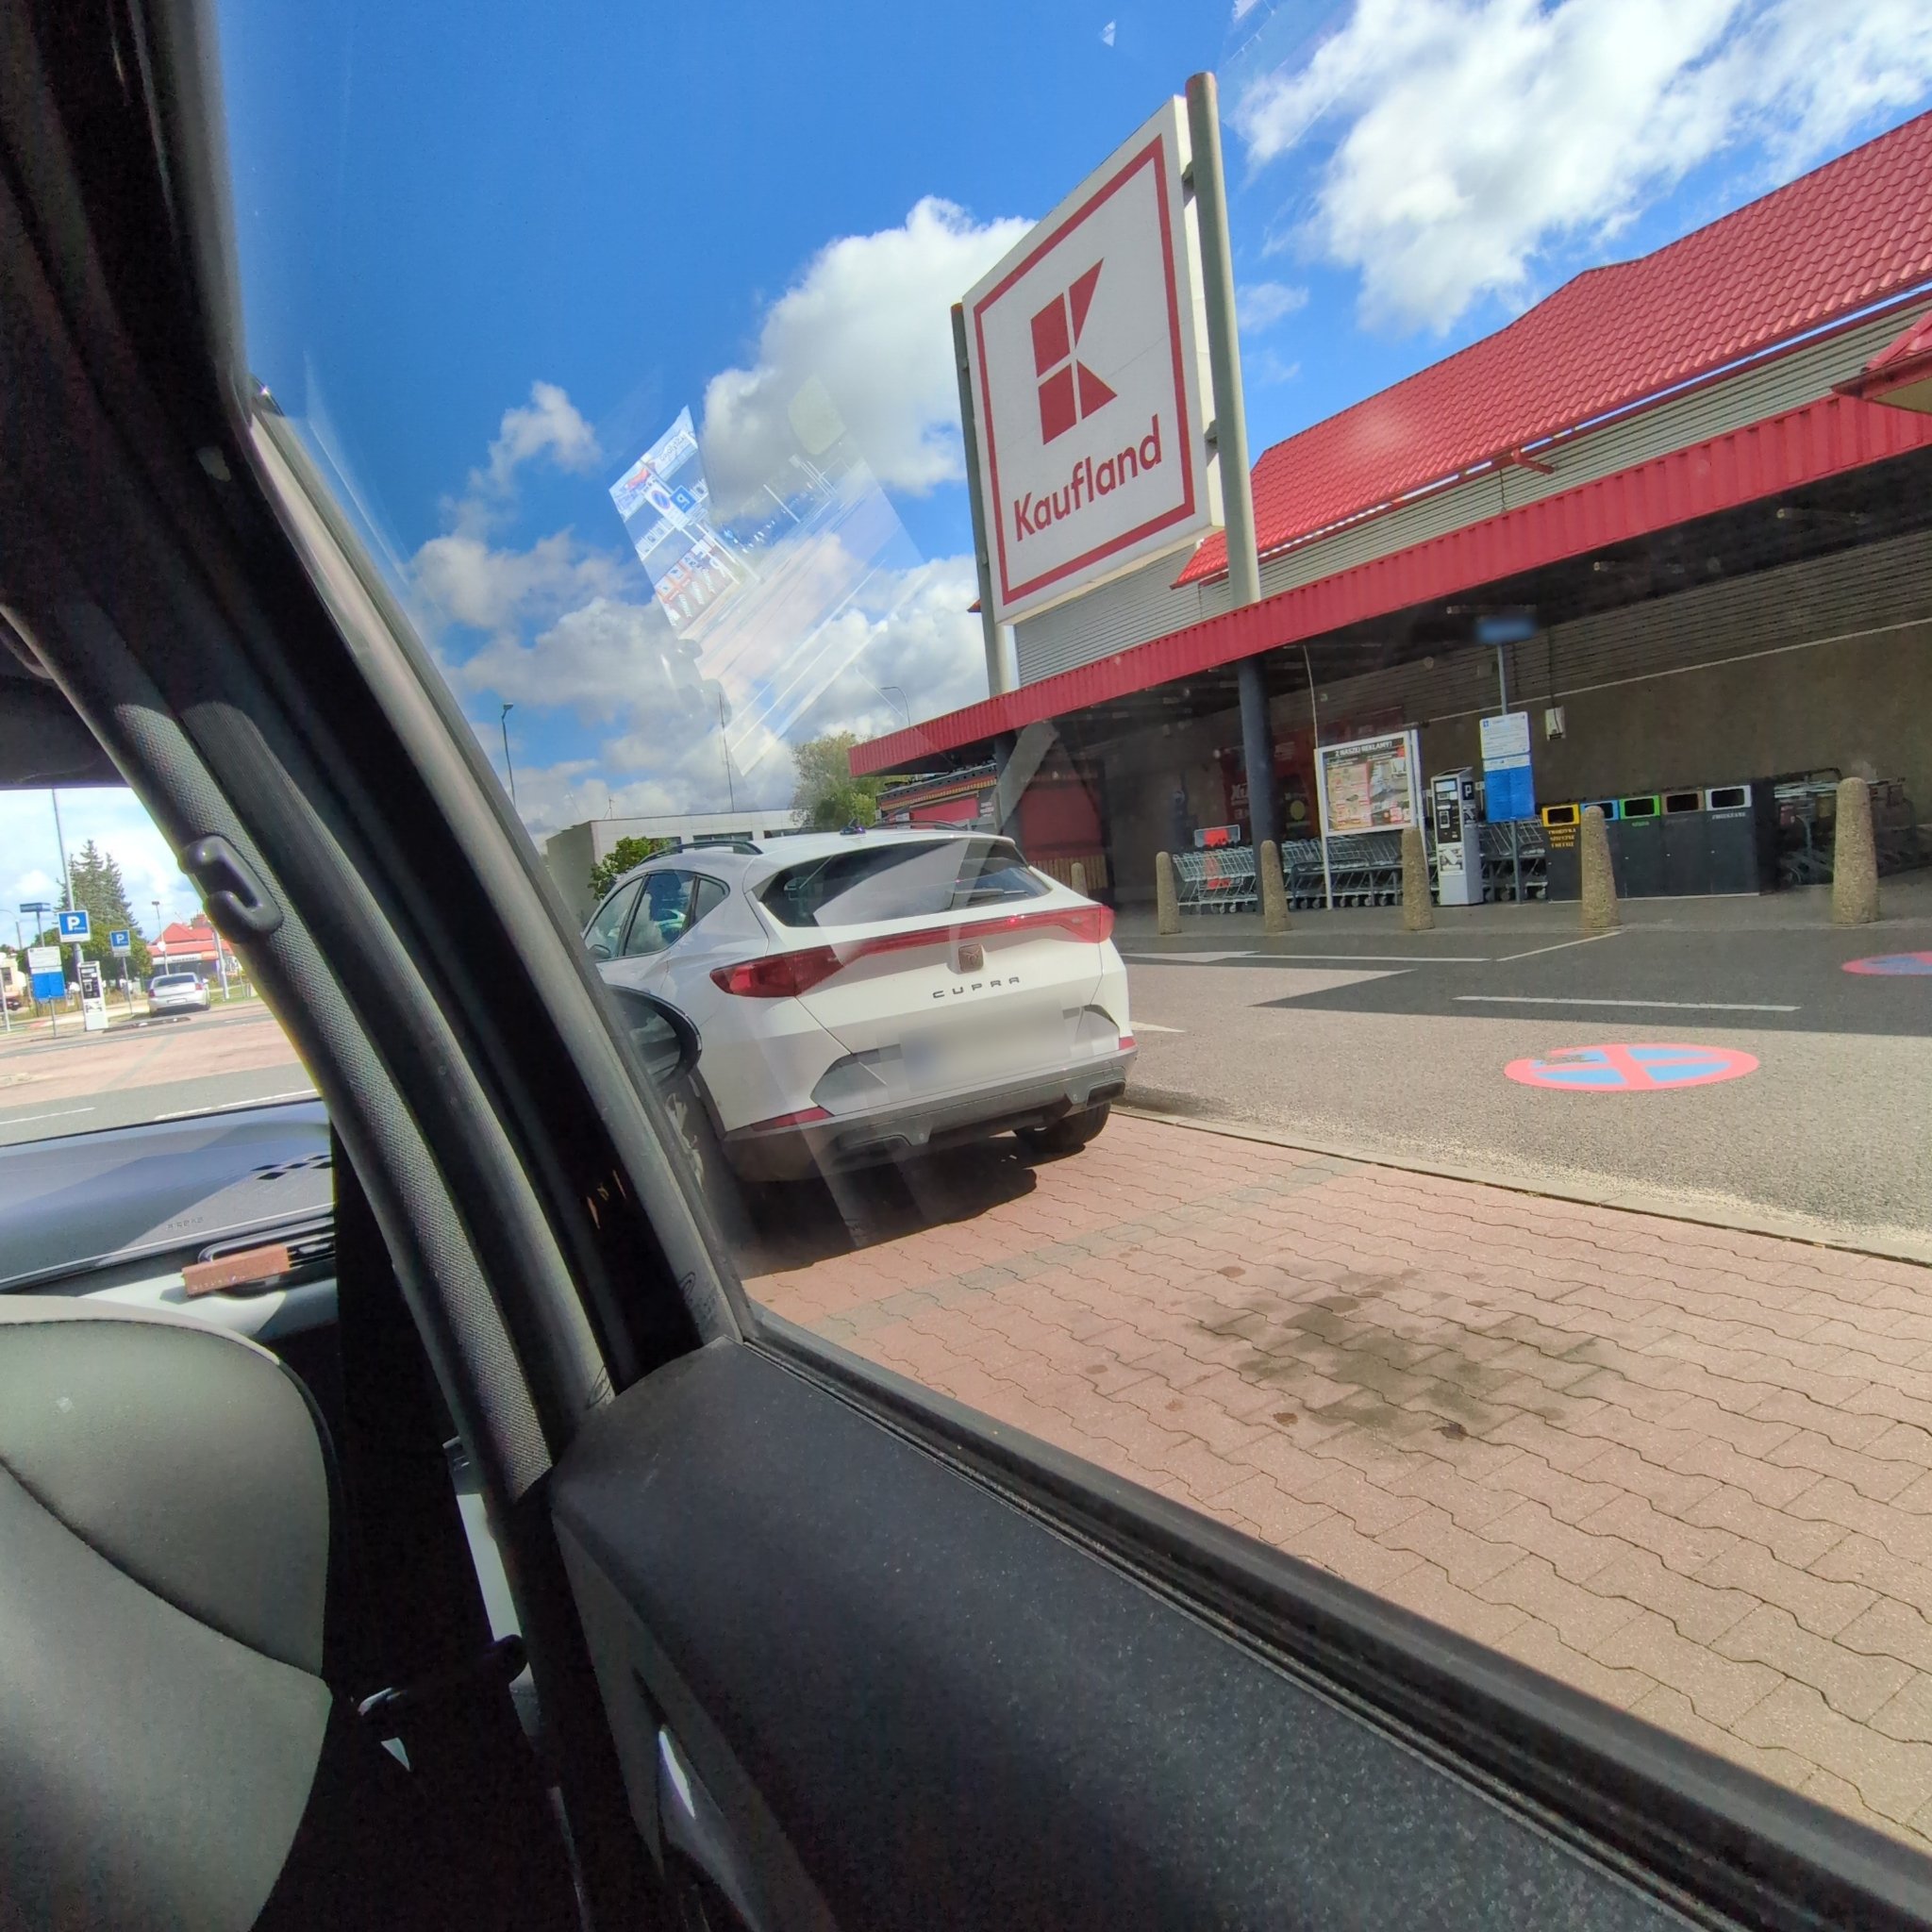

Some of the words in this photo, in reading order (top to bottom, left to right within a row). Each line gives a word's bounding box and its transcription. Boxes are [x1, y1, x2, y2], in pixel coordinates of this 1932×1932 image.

[1013, 413, 1162, 542] Kaufland
[67, 916, 80, 931] P
[116, 934, 125, 944] P
[931, 976, 1021, 999] CUPRA
